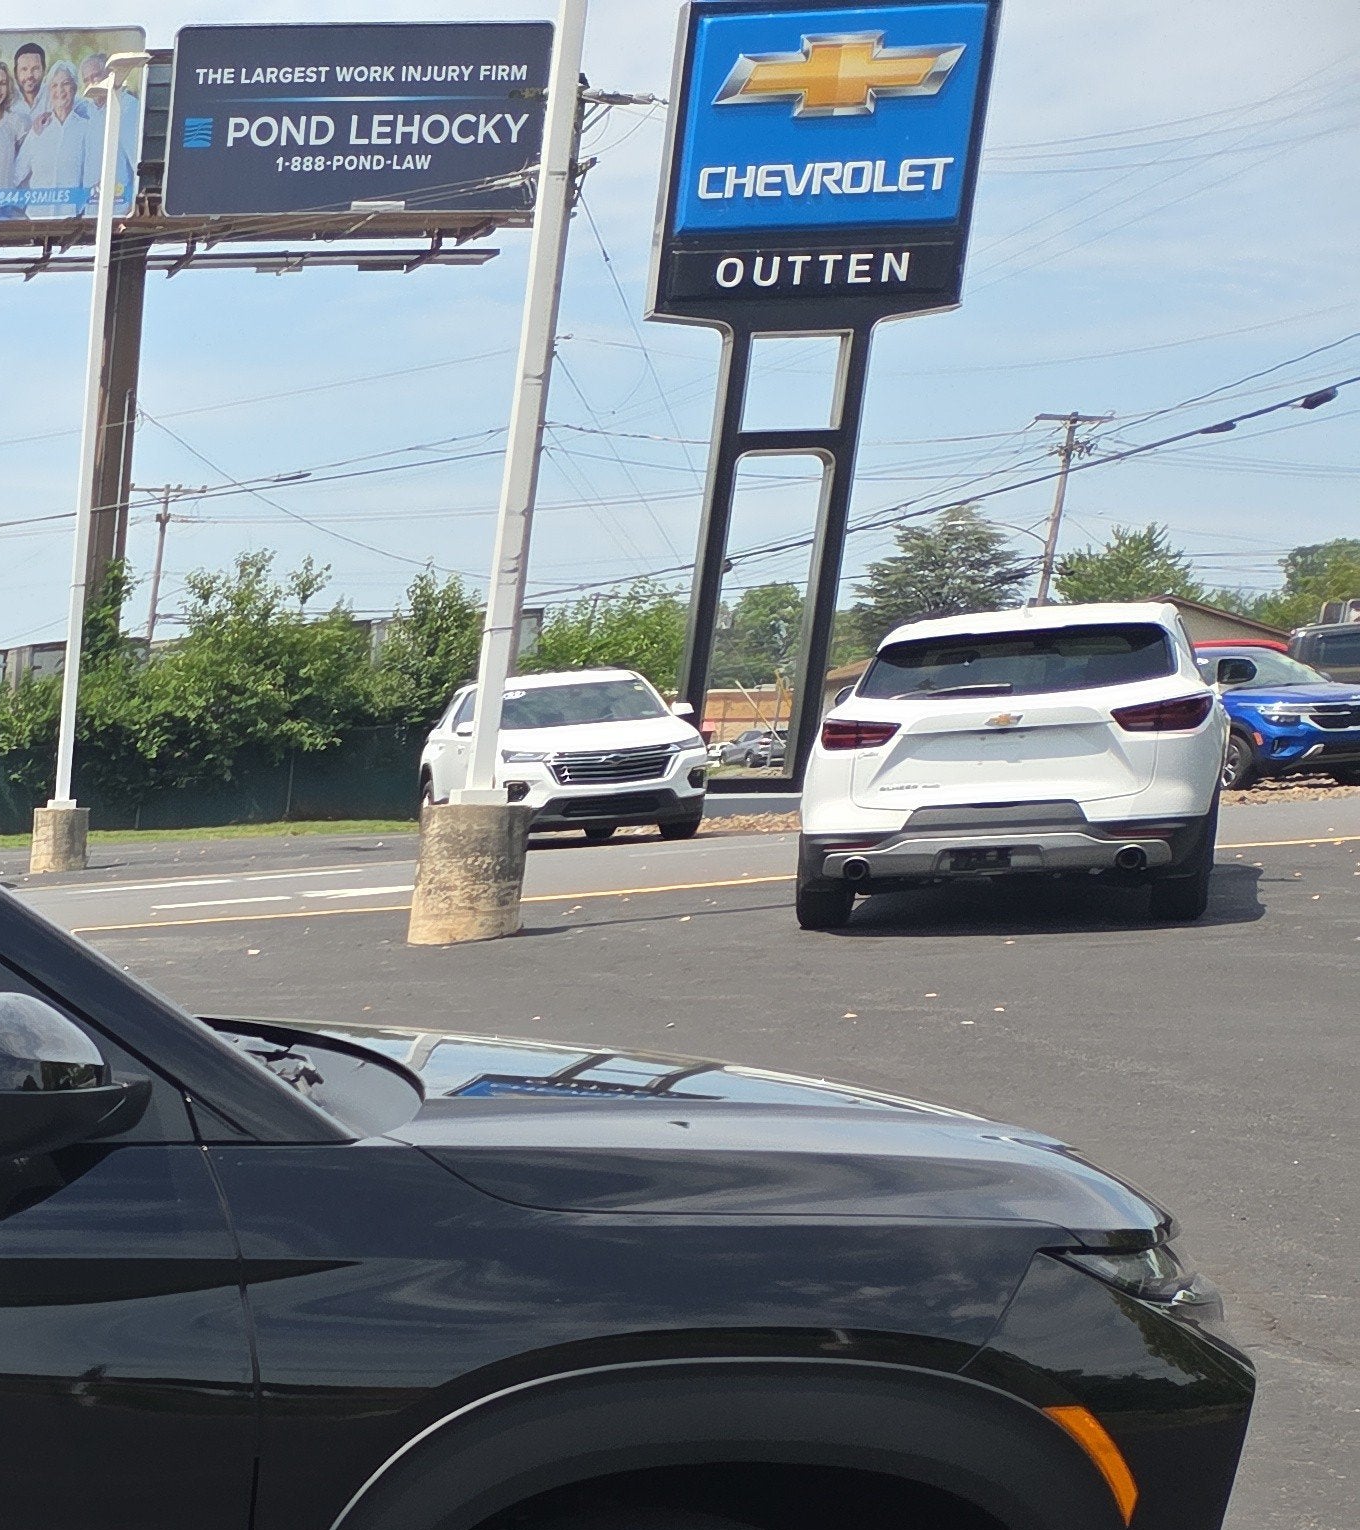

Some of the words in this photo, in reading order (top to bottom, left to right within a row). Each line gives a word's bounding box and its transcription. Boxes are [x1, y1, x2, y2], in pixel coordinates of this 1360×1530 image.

[196, 68, 235, 85] THE
[240, 66, 330, 84] LARGEST
[335, 65, 395, 83] WORK
[401, 65, 474, 82] INJURY
[479, 65, 528, 81] FIRM
[226, 115, 335, 147] POND
[349, 113, 530, 145] LEHOCKY
[275, 154, 432, 172] 1-888-POND-LAW
[697, 157, 954, 200] CHEVROLET
[715, 252, 912, 288] OUTTEN
